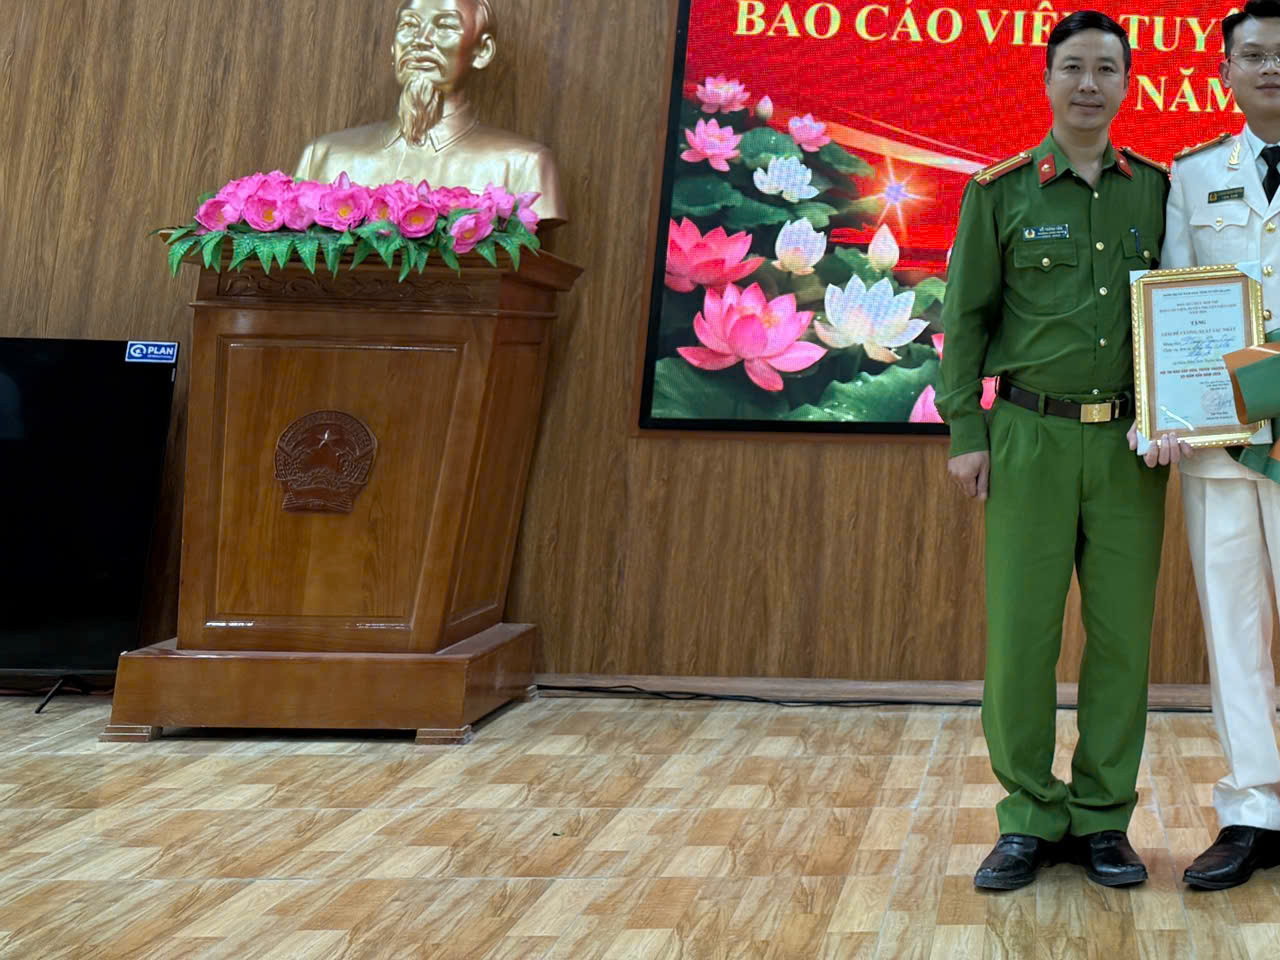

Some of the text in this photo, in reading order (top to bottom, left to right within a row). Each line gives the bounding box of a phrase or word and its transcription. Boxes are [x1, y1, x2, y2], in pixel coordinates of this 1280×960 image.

[976, 0, 1070, 46] VIÊ
[1119, 8, 1240, 54] TUY
[148, 346, 174, 355] PLAN
